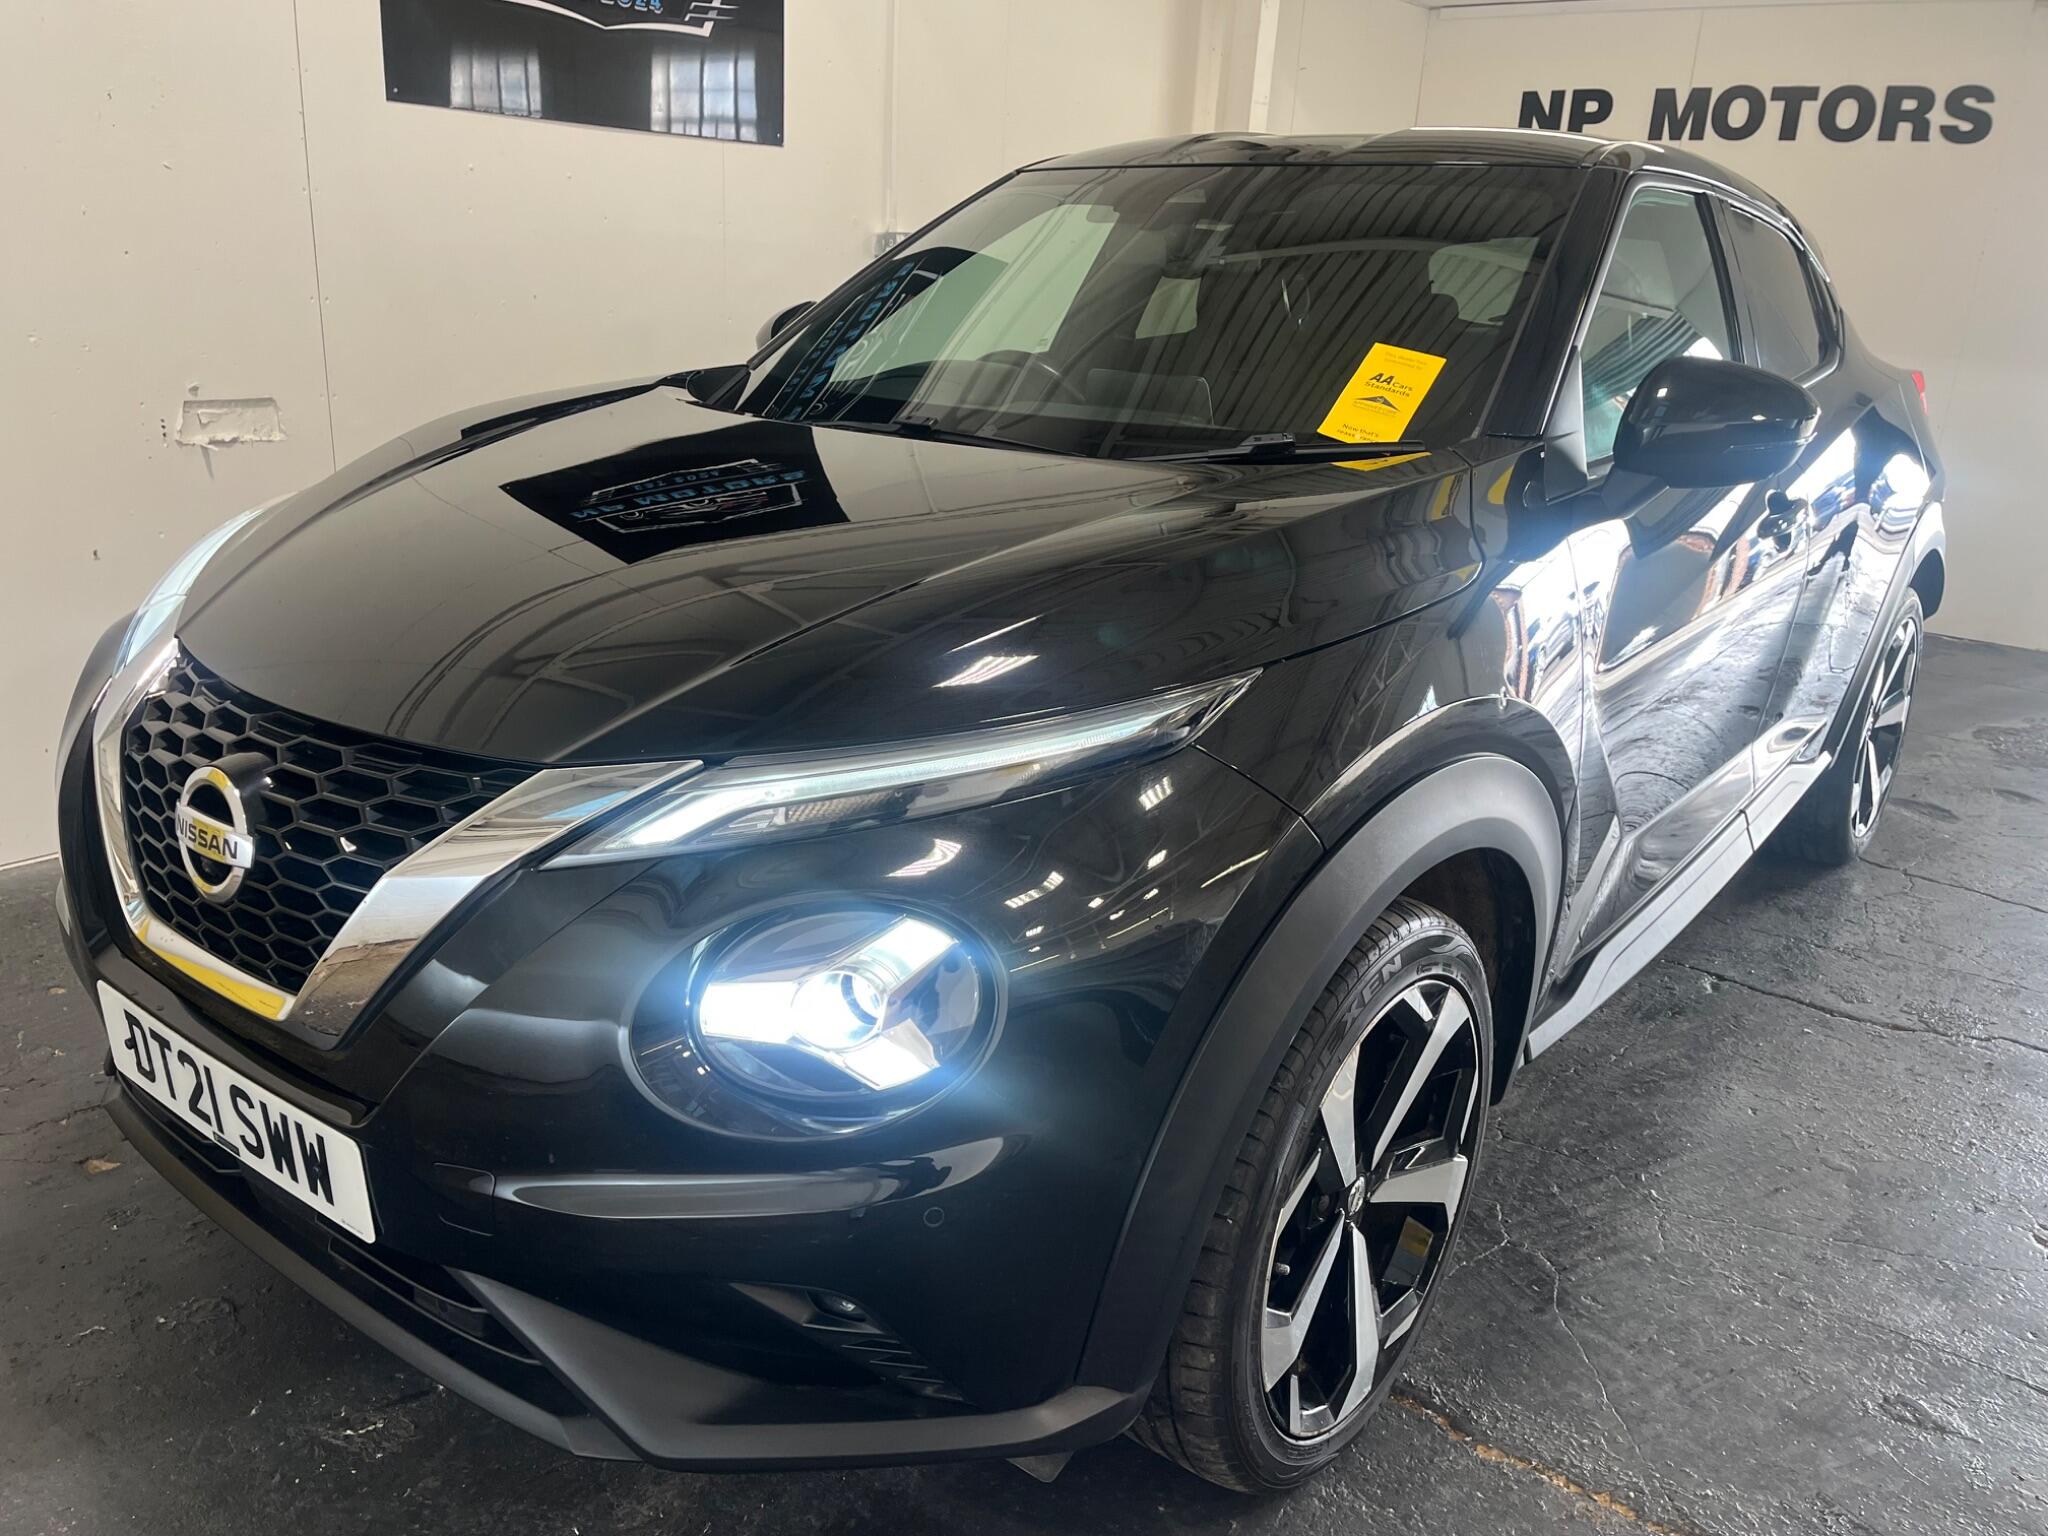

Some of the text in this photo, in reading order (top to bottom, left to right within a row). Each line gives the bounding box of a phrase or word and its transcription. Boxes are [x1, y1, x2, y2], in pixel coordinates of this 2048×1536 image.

[1518, 84, 1996, 144] NP MOTORS
[1364, 381, 1410, 398] Standards
[1369, 372, 1395, 386] AA
[176, 814, 238, 860] NISSAN
[124, 1009, 335, 1207] DT21 SWW
